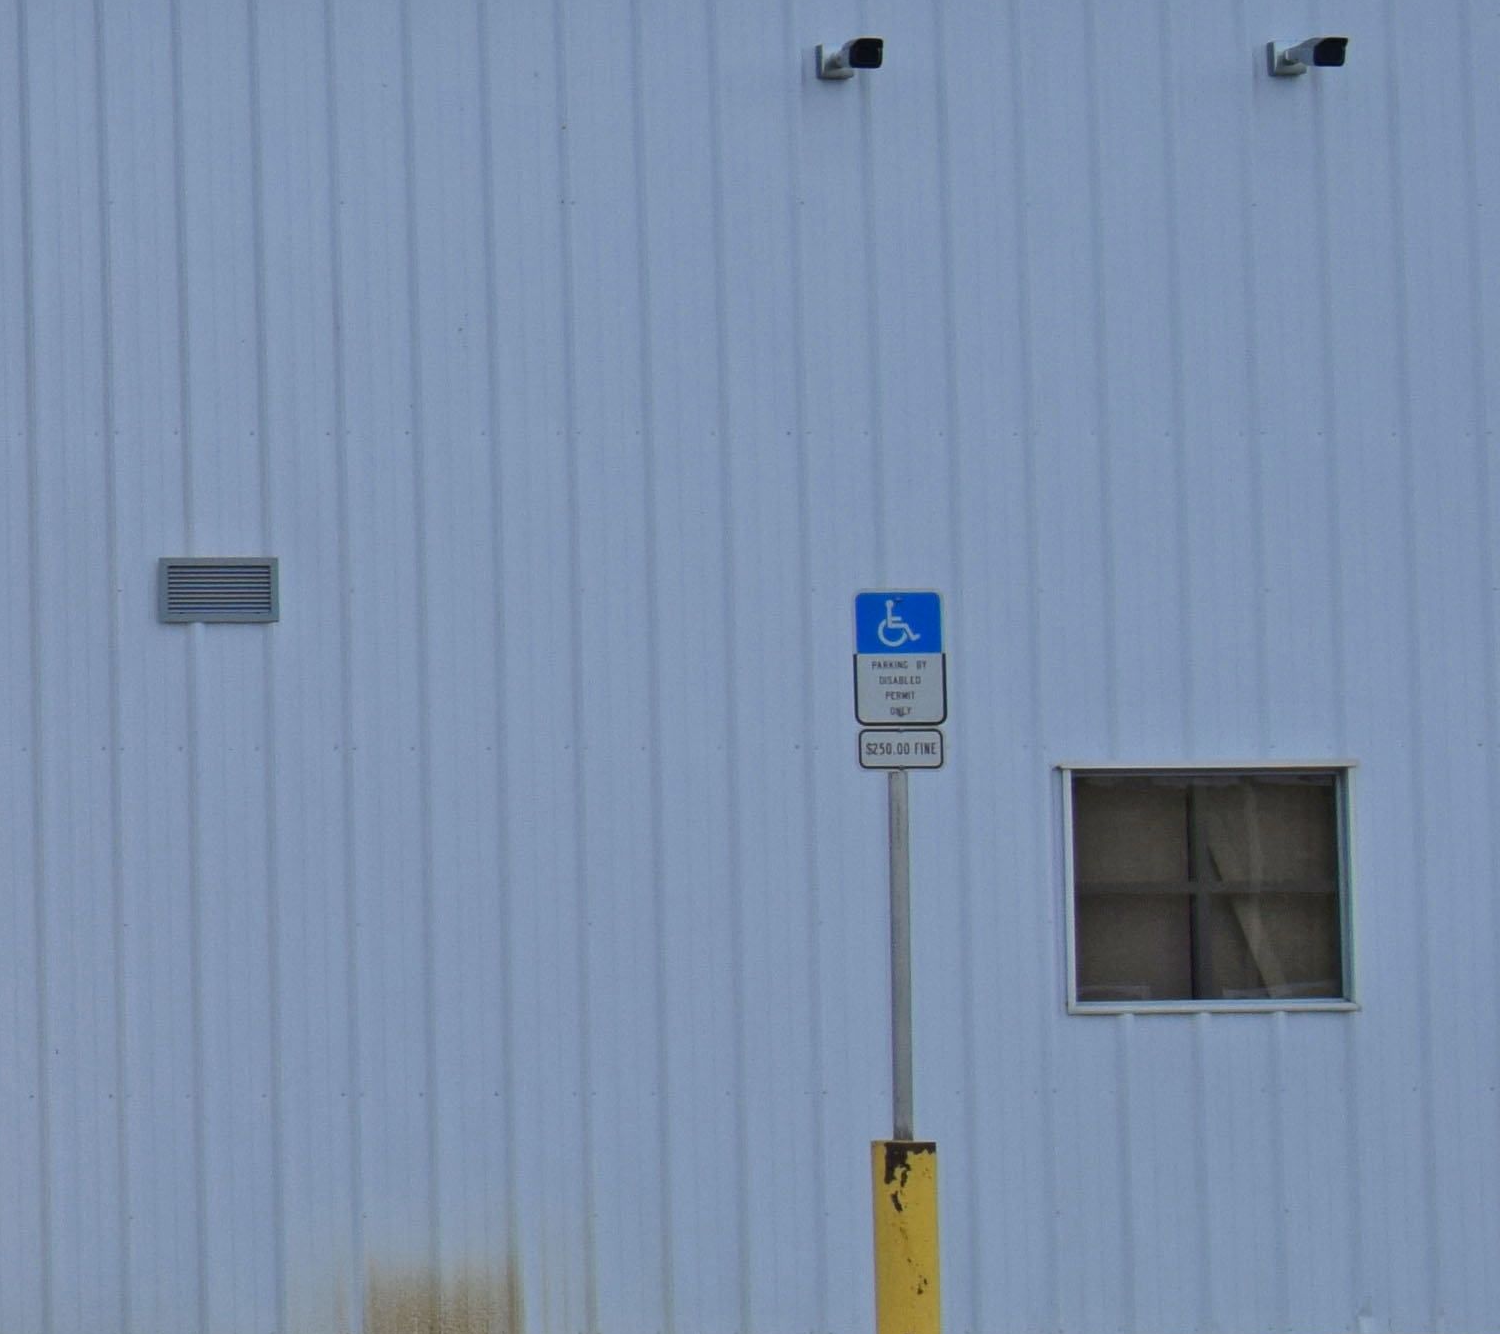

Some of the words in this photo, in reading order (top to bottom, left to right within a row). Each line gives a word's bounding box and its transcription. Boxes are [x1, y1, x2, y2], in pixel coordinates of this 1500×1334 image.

[871, 661, 909, 670] PARKING
[916, 661, 927, 670] BY
[879, 676, 921, 685] DISABLED
[885, 691, 915, 700] PERMIT
[890, 706, 911, 716] ONLY
[865, 742, 910, 755] $250.00
[914, 742, 937, 755] FINE
